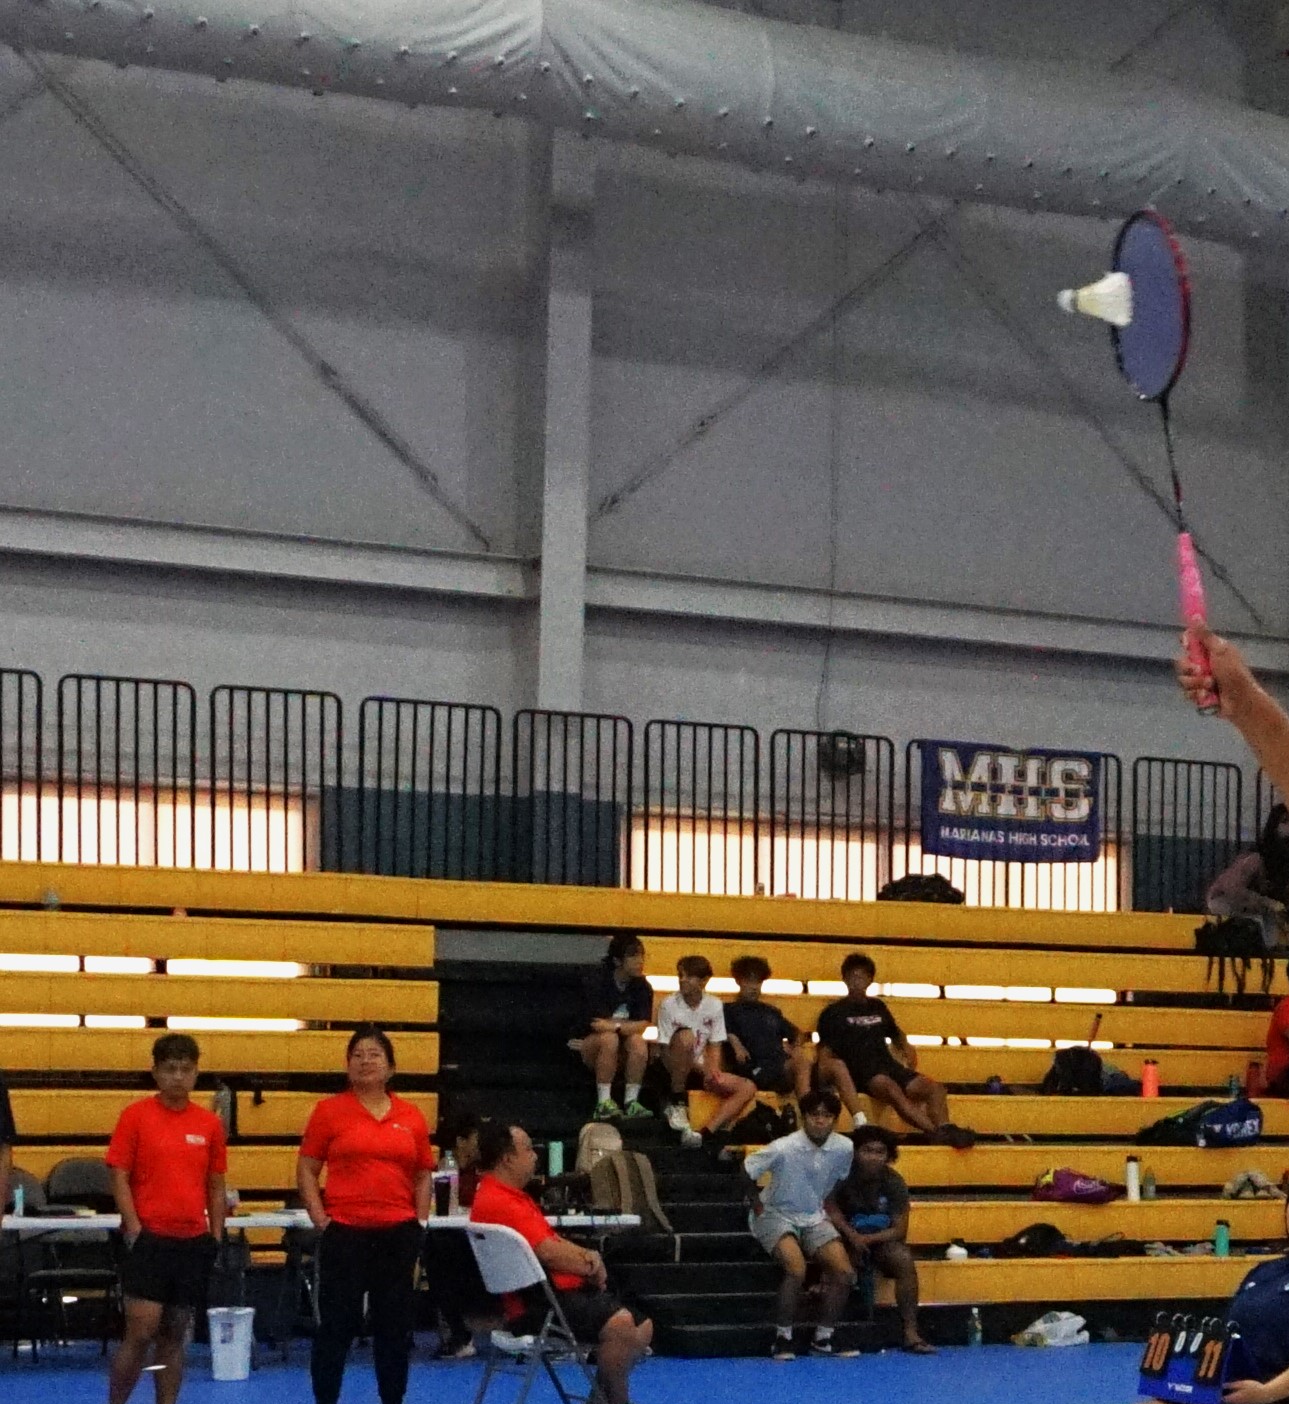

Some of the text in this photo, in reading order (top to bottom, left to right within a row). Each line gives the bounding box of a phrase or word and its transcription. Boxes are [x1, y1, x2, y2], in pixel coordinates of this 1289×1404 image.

[938, 747, 1093, 822] MHS
[940, 825, 1005, 844] MARIANAS
[1008, 830, 1038, 846] HIGH
[1143, 1332, 1171, 1371] 10
[1198, 1340, 1223, 1378] 11
